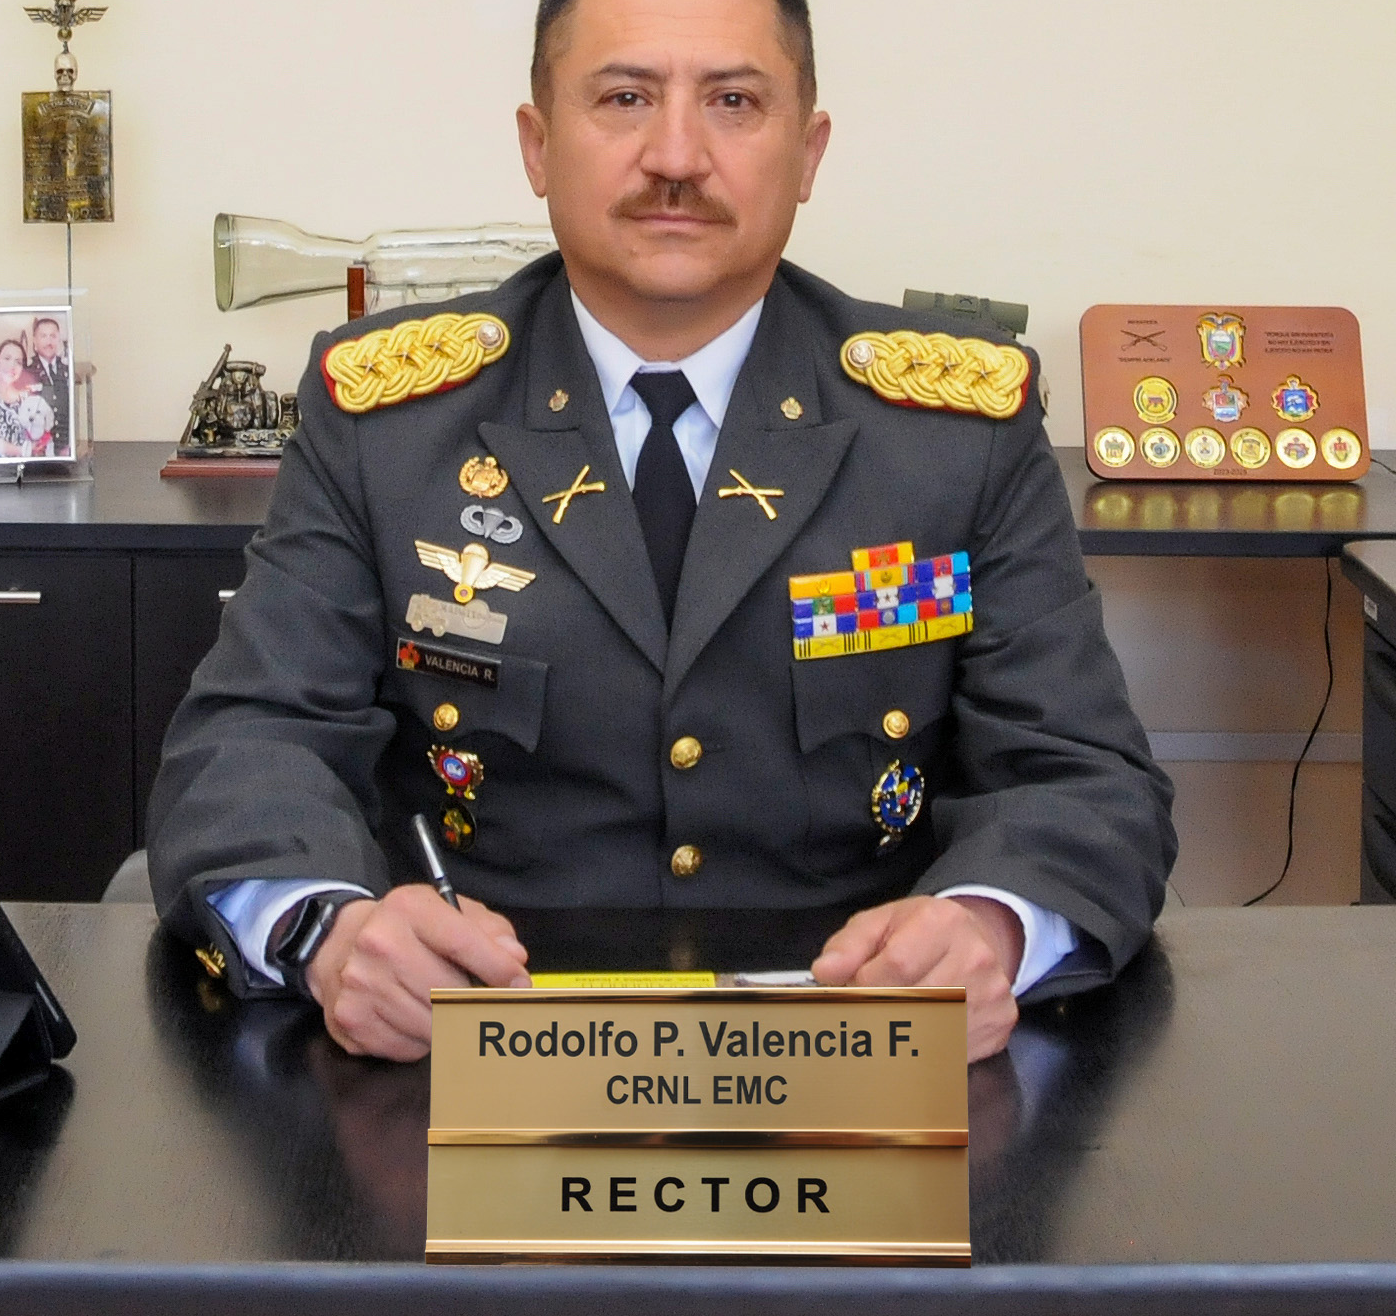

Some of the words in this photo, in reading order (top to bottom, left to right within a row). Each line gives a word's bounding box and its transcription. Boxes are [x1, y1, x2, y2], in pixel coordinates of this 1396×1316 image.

[425, 654, 479, 677] VALENCIA
[484, 669, 495, 681] R.
[479, 1020, 638, 1057] Rodolfo
[652, 1022, 685, 1057] P.
[699, 1020, 873, 1057] Valencia
[888, 1022, 920, 1057] F.
[606, 1075, 701, 1105] CRNL
[713, 1075, 788, 1105] EMC
[561, 1177, 830, 1213] RECTOR
